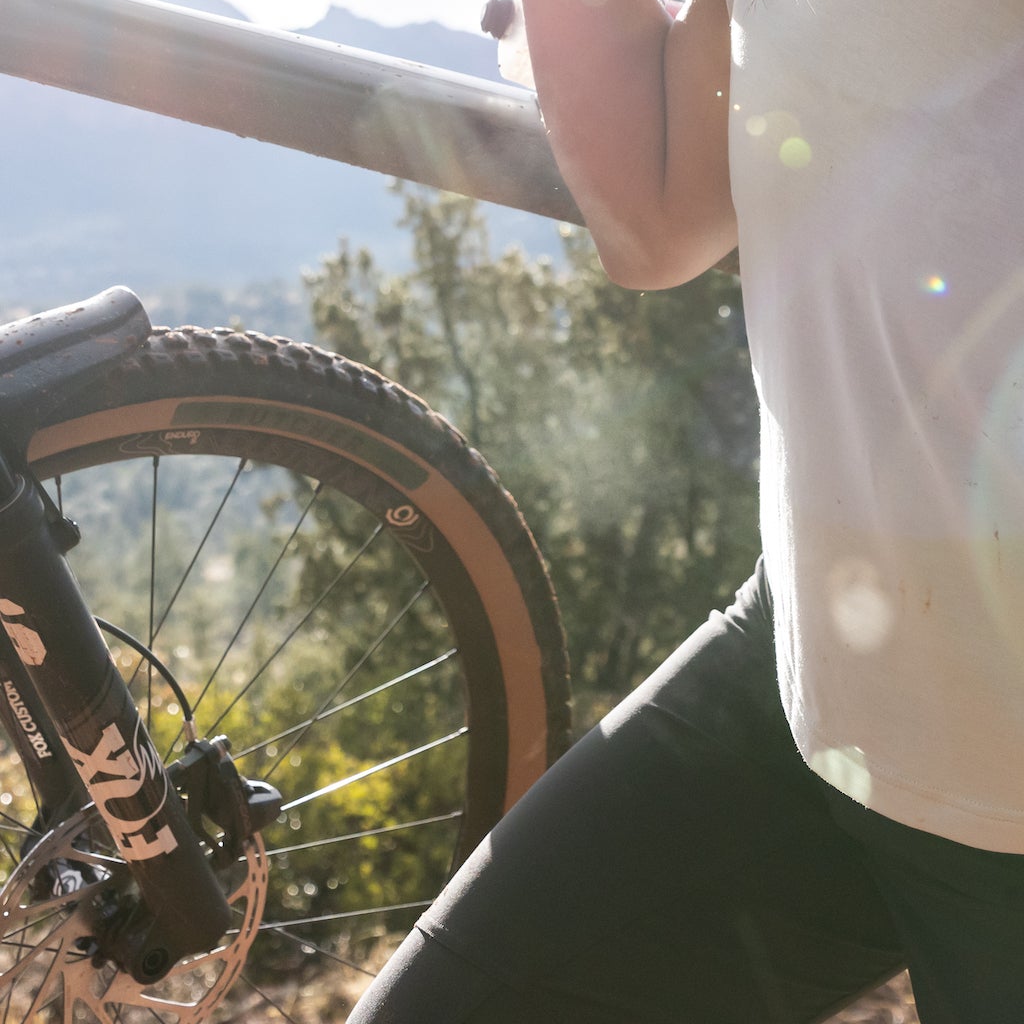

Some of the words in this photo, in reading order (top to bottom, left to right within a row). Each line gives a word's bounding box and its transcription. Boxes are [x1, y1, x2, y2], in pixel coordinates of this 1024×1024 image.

[4, 680, 38, 733] CUSTOM
[29, 734, 53, 759] FOX
[60, 720, 179, 862] FOX
